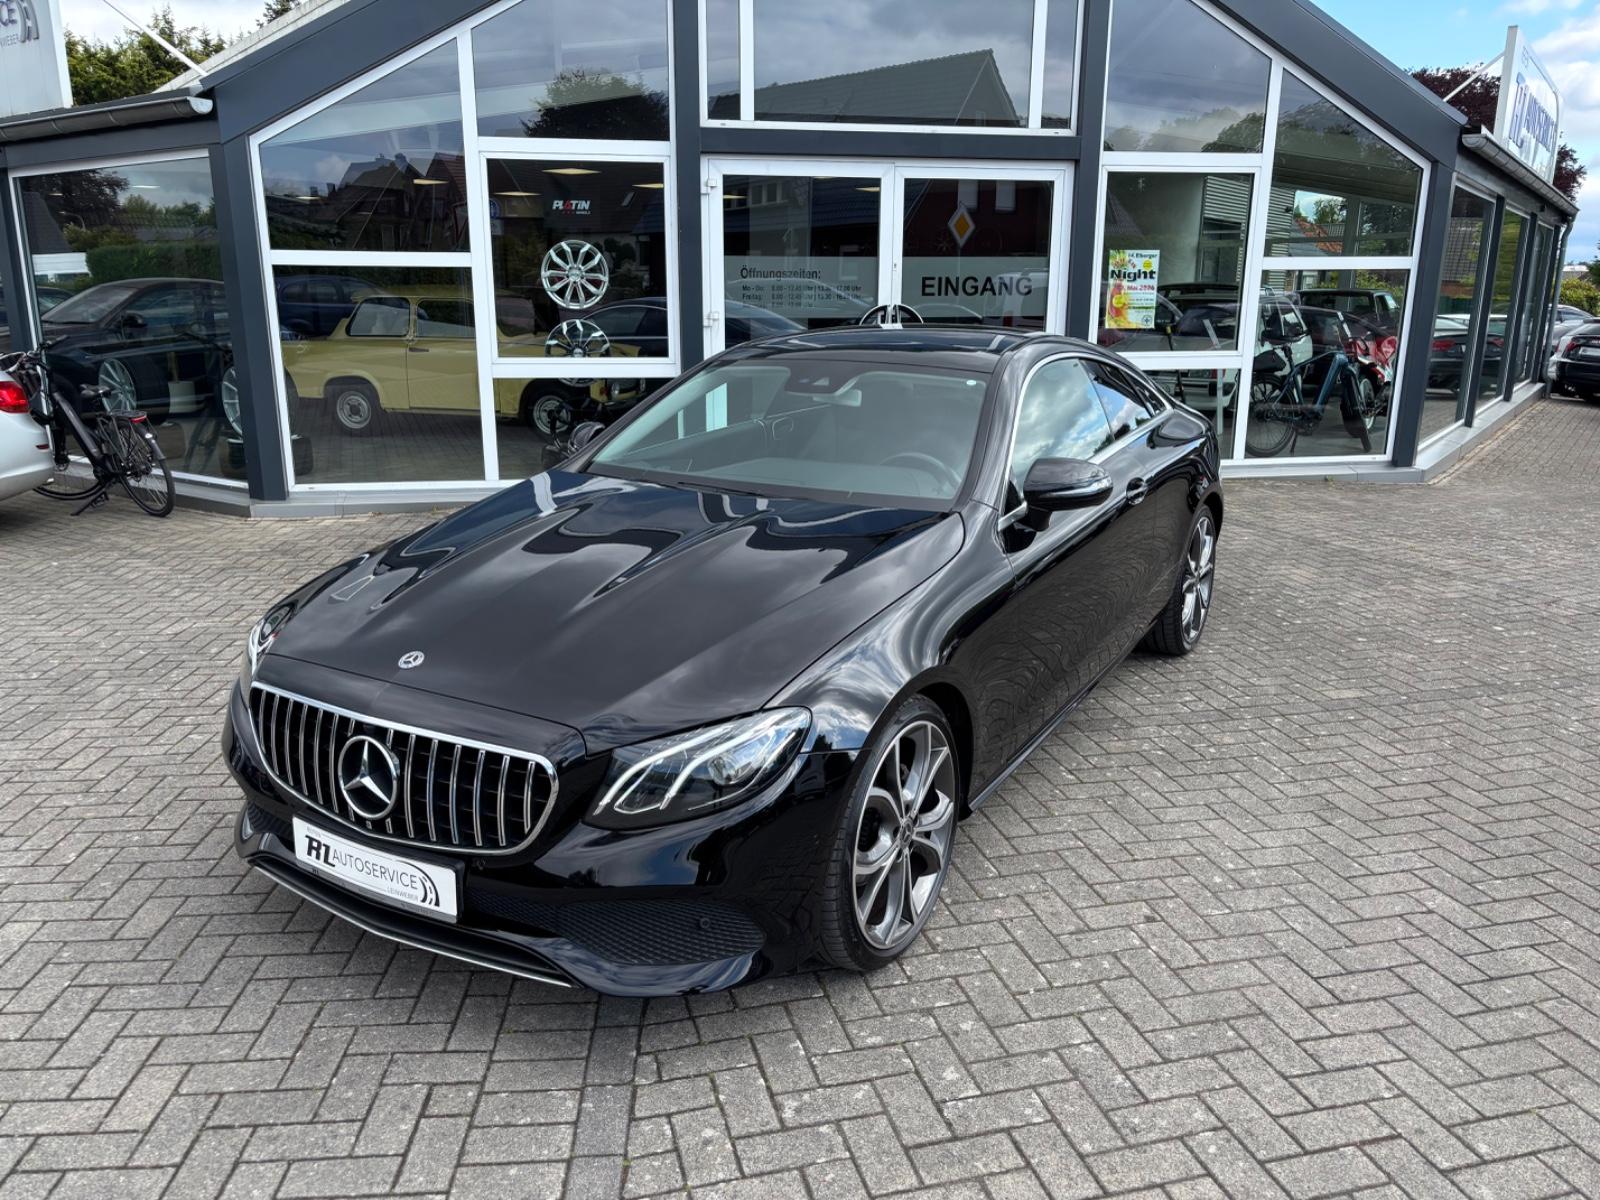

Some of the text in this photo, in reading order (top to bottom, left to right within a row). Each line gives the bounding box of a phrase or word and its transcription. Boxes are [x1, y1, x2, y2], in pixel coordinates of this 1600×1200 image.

[740, 264, 822, 281] Öffnungszeiten:
[1110, 268, 1156, 282] Night
[921, 276, 1033, 297] EINGANG
[305, 835, 418, 890] RL AUTOSERVICE
